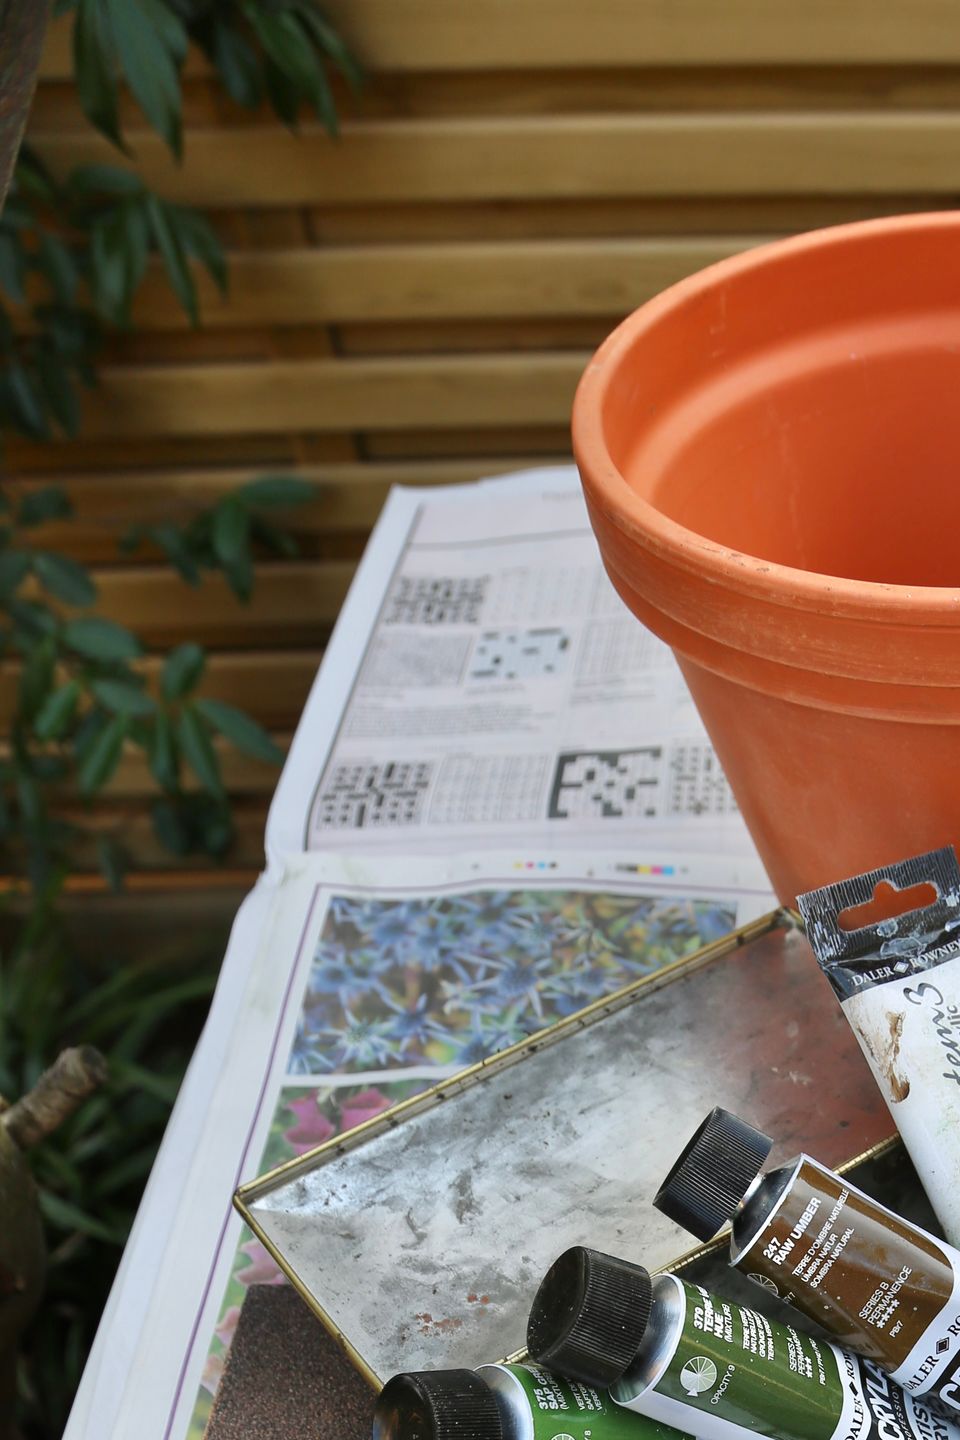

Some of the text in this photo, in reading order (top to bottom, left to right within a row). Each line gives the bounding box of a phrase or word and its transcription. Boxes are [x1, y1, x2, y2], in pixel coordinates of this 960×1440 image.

[851, 966, 894, 986] DALER
[772, 1239, 795, 1266] RAW
[790, 1197, 822, 1240] UMBER
[763, 1236, 781, 1261] 247
[810, 1227, 855, 1289] SOMBRA NATURAL
[818, 1233, 839, 1260] NATUR
[792, 1255, 813, 1277] TERRE
[858, 1281, 890, 1320] SERIES B
[867, 1265, 913, 1325] PERMANENCE
[694, 1306, 704, 1329] 379
[703, 1297, 714, 1333] TERRE
[714, 1312, 724, 1338] HUE
[889, 1320, 904, 1338] PBr7
[787, 1342, 798, 1372] SERIES
[710, 1364, 736, 1405] OPACITY 9
[903, 1355, 939, 1390] DALER
[536, 1388, 549, 1410] 375
[543, 1387, 559, 1410] SAP
